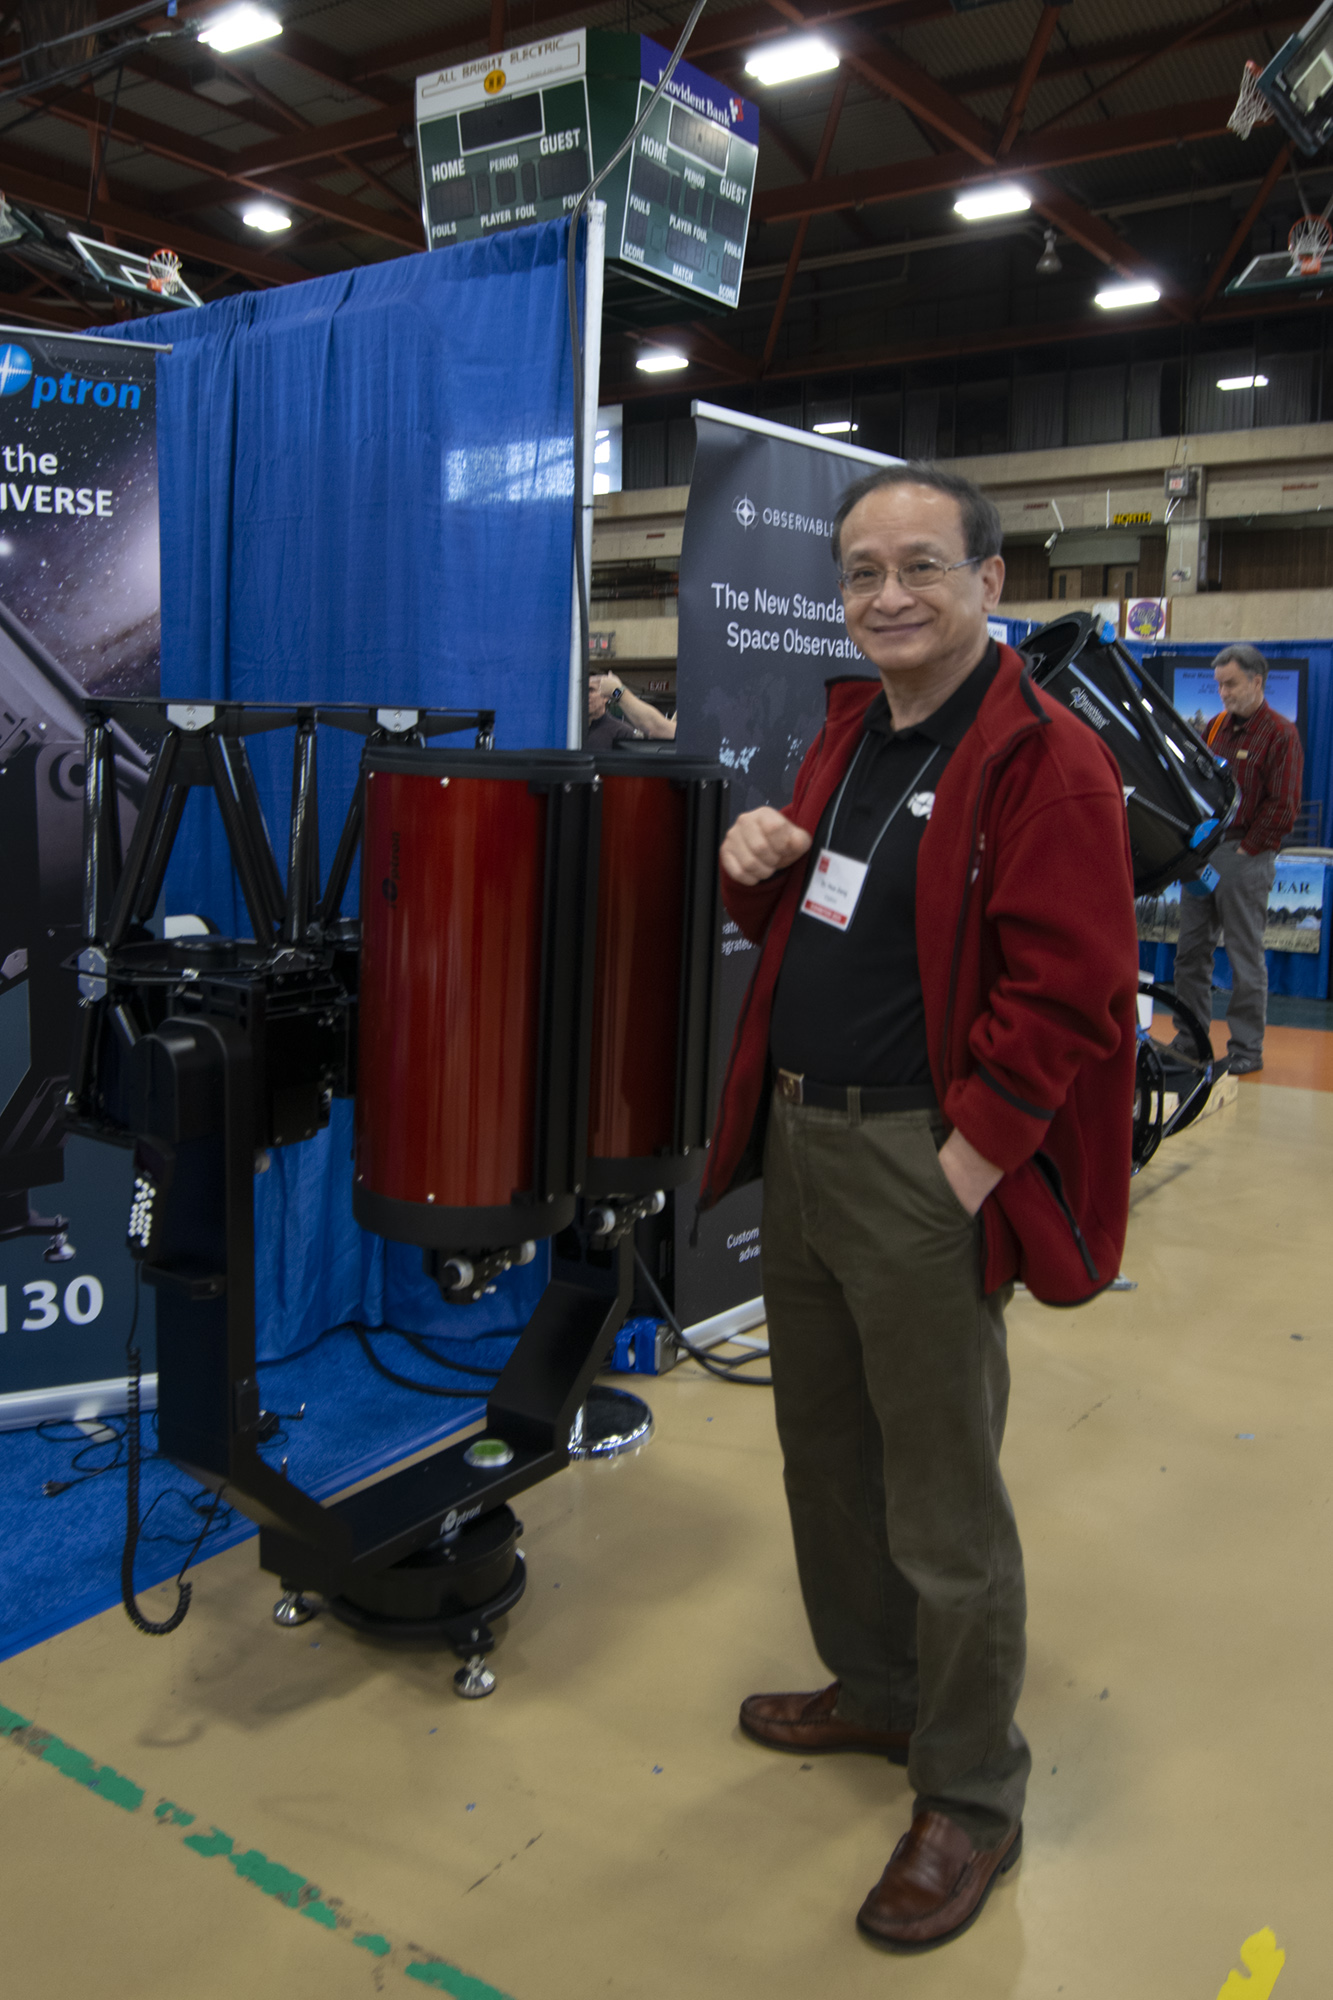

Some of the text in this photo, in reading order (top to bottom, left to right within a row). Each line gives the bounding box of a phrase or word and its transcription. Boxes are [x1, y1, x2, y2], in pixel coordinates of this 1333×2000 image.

[436, 72, 457, 85] ALL
[462, 57, 503, 79] BRIGHT
[510, 38, 564, 65] ELECTRIC
[706, 98, 730, 128] Bank
[540, 128, 580, 156] GUEST
[641, 133, 668, 165] HOME
[431, 158, 466, 183] HOME
[489, 154, 519, 173] PERIOD
[684, 167, 706, 189] PERIOD
[719, 178, 747, 206] GUEST
[480, 204, 537, 228] PLAYER FOUL
[630, 194, 650, 216] FOULS
[431, 221, 457, 239] FOULS
[669, 214, 708, 244] PLAYER FOUL
[623, 242, 645, 263] SCORE
[723, 240, 742, 260] FOULS
[672, 264, 694, 283] MATCH
[718, 284, 736, 301] SCORE
[2, 443, 58, 475] the
[1113, 512, 1151, 525] NORTH
[711, 582, 847, 624] The New Standa
[727, 621, 866, 661] Space Observatio
[1273, 880, 1310, 895] EAR
[726, 1227, 760, 1250] Custom
